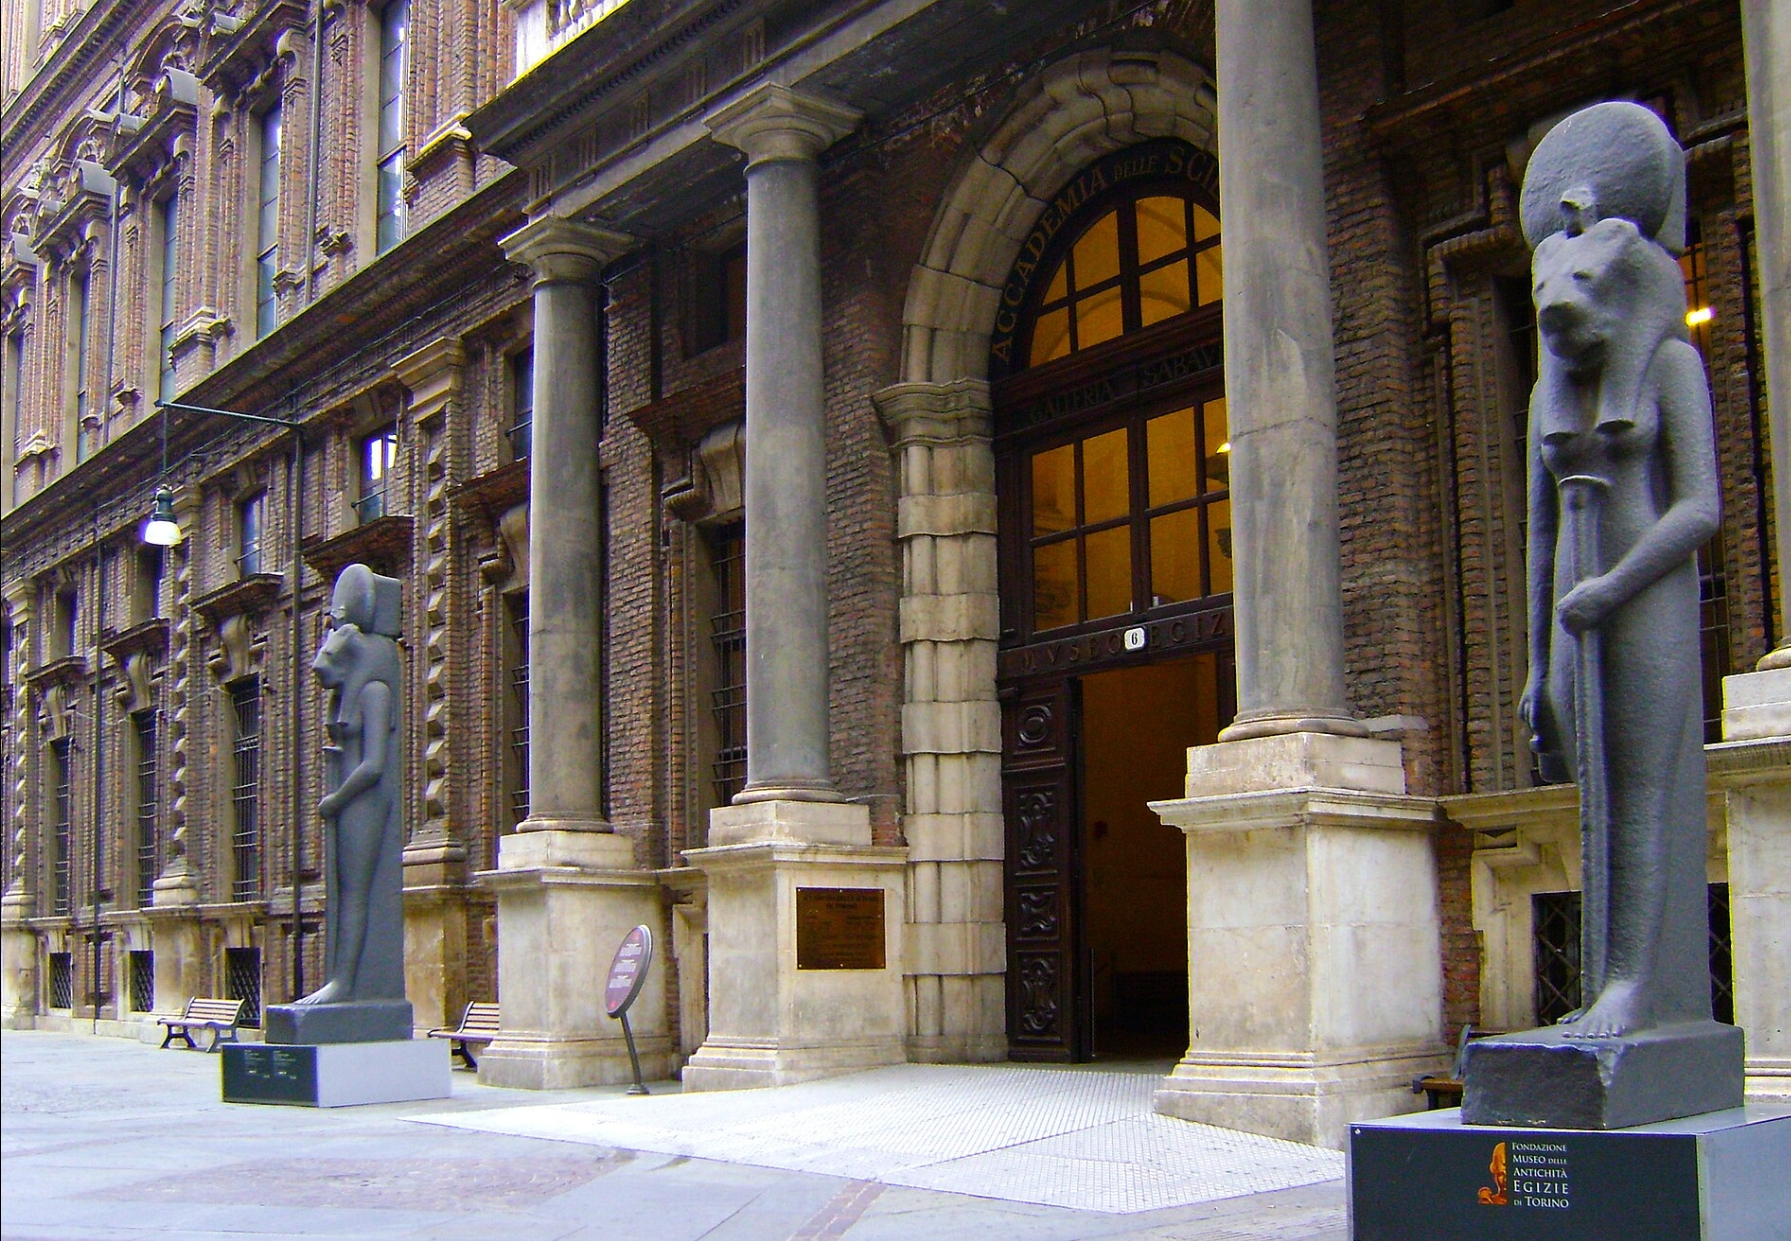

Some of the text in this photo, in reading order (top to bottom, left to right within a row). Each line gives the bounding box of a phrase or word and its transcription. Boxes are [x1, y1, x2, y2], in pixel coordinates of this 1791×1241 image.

[991, 165, 1109, 364] ACCADEMIA
[1114, 155, 1158, 181] DELLE
[1131, 632, 1138, 646] 6
[1511, 1142, 1567, 1152] FONDAZIONE
[1512, 1154, 1546, 1164] MUSEO
[1513, 1167, 1568, 1178] ANTICHITÀ
[1513, 1180, 1569, 1194] EGIZIE
[1524, 1196, 1569, 1208] TORINO
